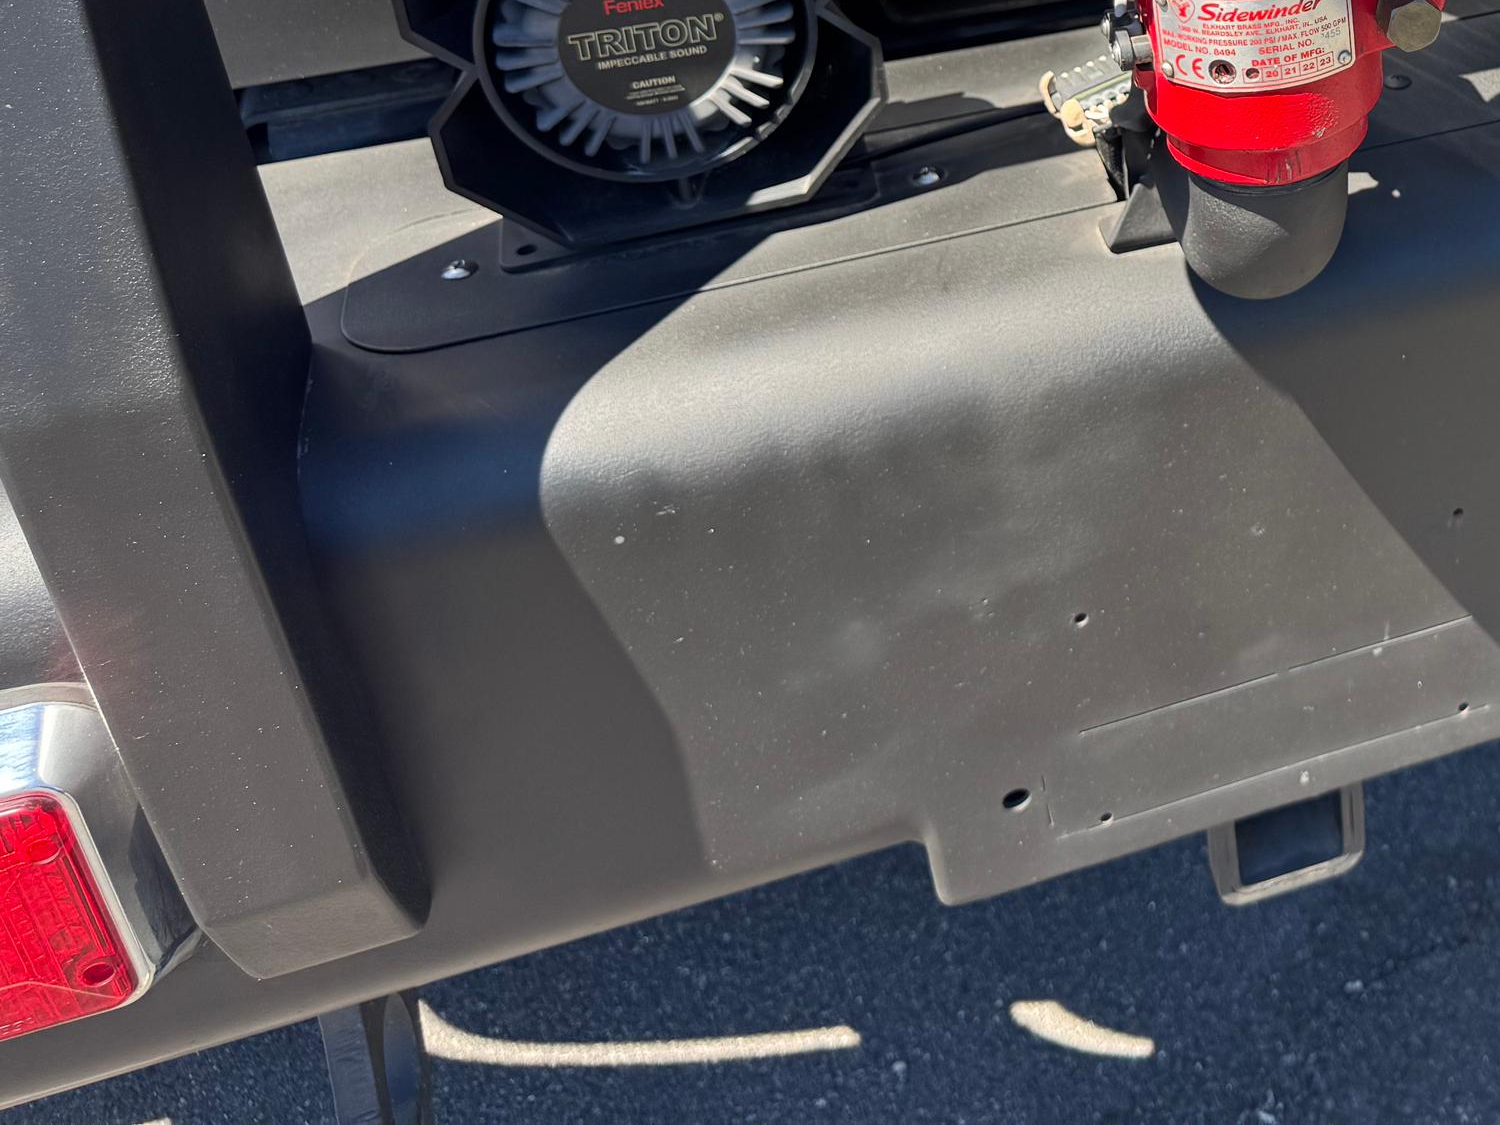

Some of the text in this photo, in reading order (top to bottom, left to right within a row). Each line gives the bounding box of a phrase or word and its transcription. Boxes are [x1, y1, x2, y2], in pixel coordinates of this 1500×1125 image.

[1201, 29, 1243, 37] BEARDSLEY
[1314, 15, 1328, 24] USA
[1300, 27, 1320, 38] FLOW
[1332, 17, 1346, 27] GPM
[1163, 38, 1193, 52] MODEL
[1195, 45, 1211, 55] NO.
[1258, 43, 1295, 55] SERIAL
[1297, 38, 1315, 49] NO.
[597, 44, 708, 71] IMPECCABLE SOUND
[1251, 47, 1325, 67] DATE OF MFG:
[1265, 57, 1331, 78] 20 21 22 23
[631, 75, 676, 89] CAUTION
